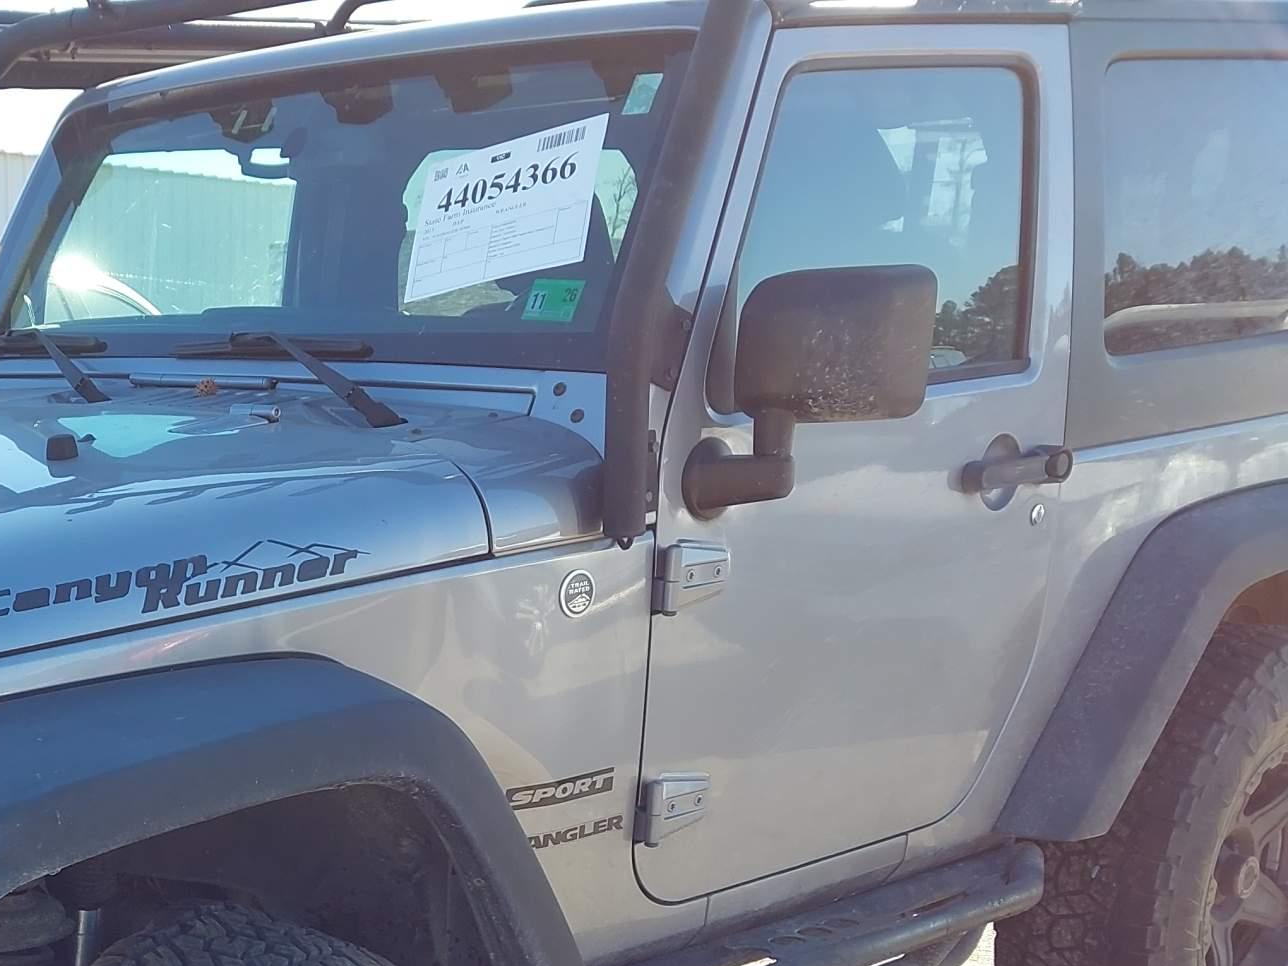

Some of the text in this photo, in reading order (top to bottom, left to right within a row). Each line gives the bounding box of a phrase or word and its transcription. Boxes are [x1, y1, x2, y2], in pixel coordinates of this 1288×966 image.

[437, 151, 579, 213] 44054366
[531, 292, 546, 310] 11
[138, 550, 358, 614] Runner
[511, 773, 609, 805] SPORT
[528, 815, 623, 849] ANGLER
